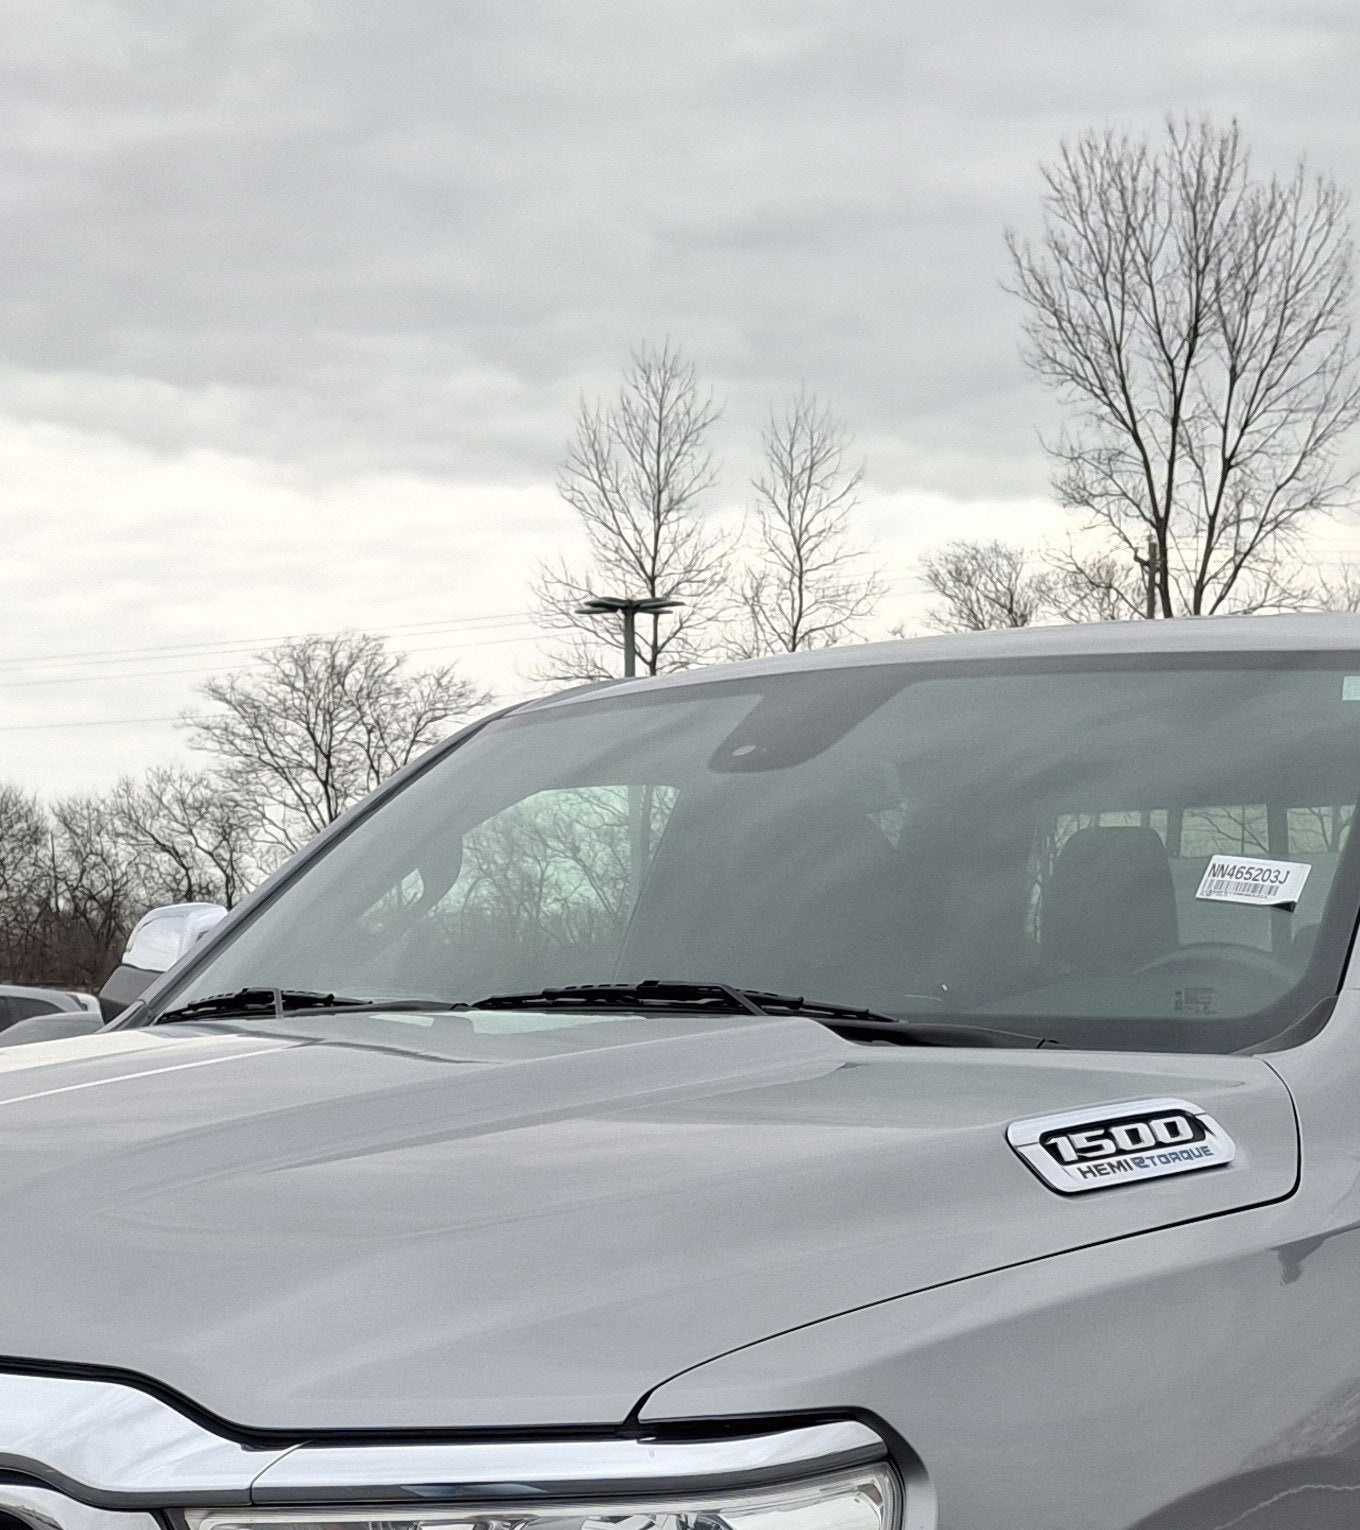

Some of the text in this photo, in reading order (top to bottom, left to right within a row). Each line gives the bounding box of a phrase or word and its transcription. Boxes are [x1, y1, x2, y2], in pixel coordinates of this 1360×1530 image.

[1207, 862, 1291, 885] NN465203J
[1045, 1115, 1194, 1162] 1500
[1076, 1158, 1135, 1179] HEMI
